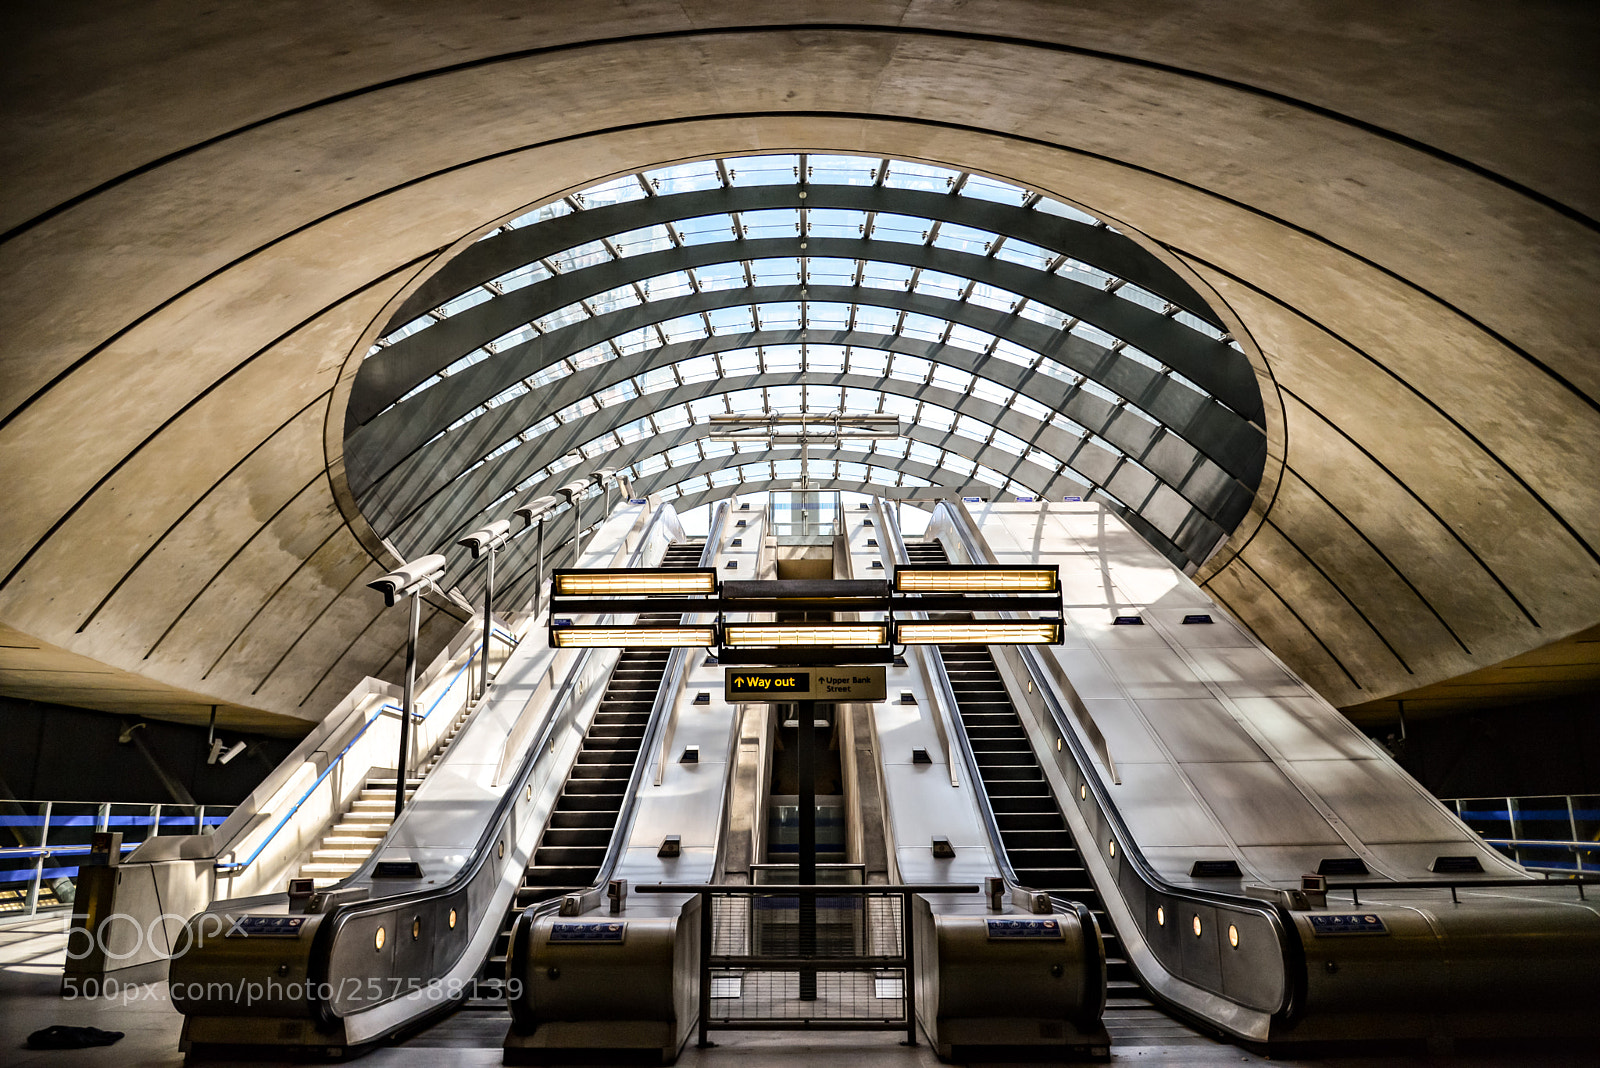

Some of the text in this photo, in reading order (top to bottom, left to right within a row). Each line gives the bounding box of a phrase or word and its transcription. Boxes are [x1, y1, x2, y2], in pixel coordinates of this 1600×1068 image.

[747, 676, 795, 689] Way out
[826, 676, 871, 686] Upper Bank
[826, 685, 851, 693] Street
